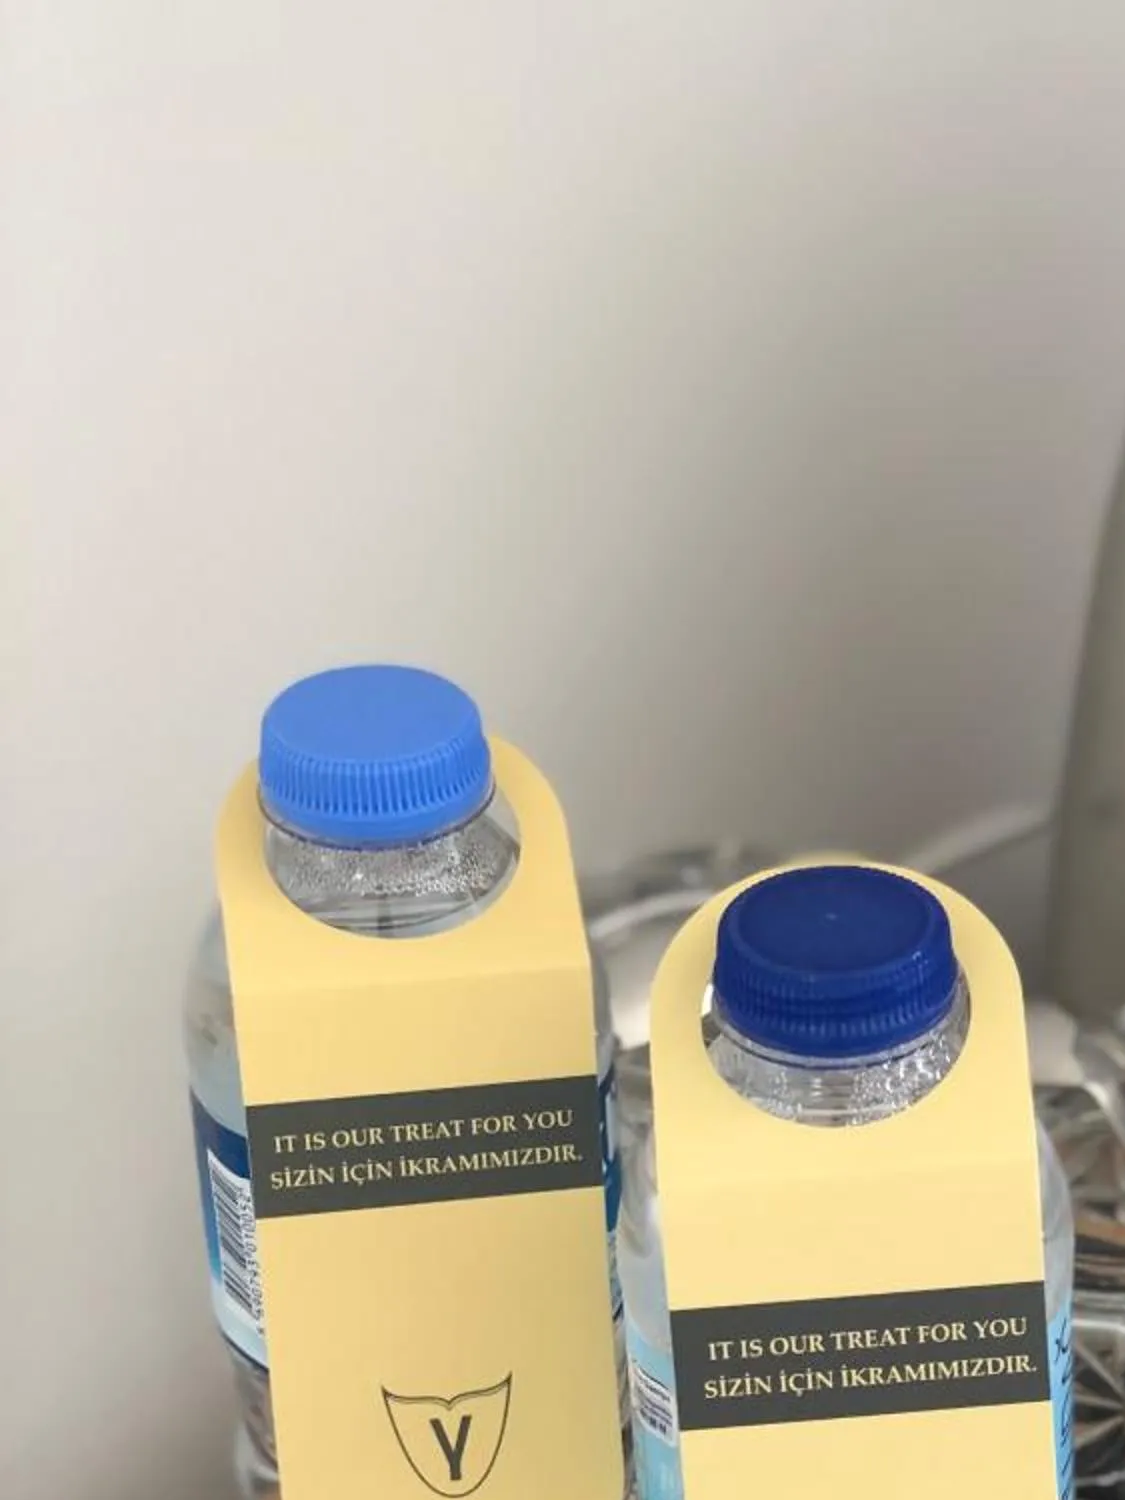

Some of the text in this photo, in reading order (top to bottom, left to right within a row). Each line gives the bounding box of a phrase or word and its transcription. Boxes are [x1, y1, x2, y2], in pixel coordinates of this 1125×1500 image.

[273, 1108, 573, 1153] IT IS OUR TREAT FOR YOU
[269, 1143, 584, 1190] SİZİN İÇİN İKRAMIMIZDIR.
[707, 1316, 1028, 1361] IT IS OUR TREAT FOR YOU
[703, 1354, 1038, 1400] SİZİN İÇİN İKRAMIMIZDIR.
[429, 1414, 473, 1482] Y
